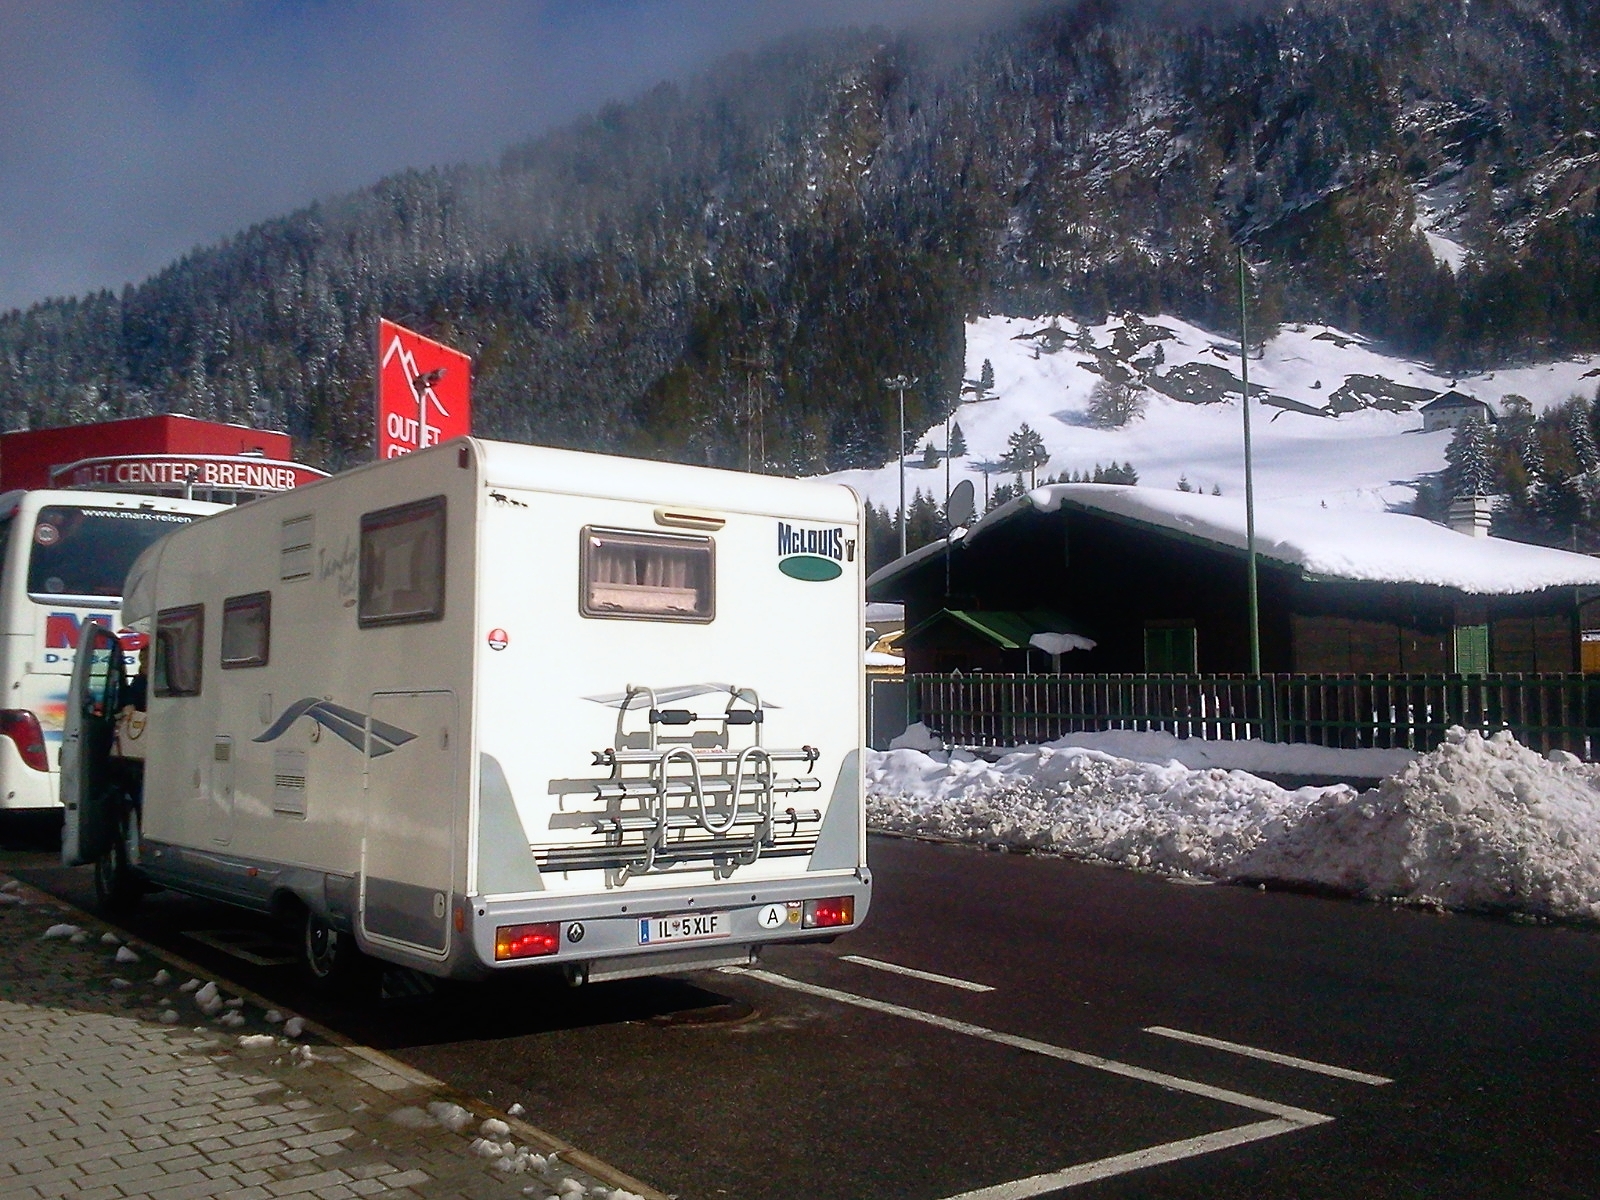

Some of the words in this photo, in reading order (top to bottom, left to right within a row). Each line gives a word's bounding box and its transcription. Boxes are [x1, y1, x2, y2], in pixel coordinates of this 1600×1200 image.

[387, 412, 442, 449] OUTET
[116, 463, 199, 483] CENTER
[205, 463, 296, 489] BRENNER
[767, 908, 779, 925] A
